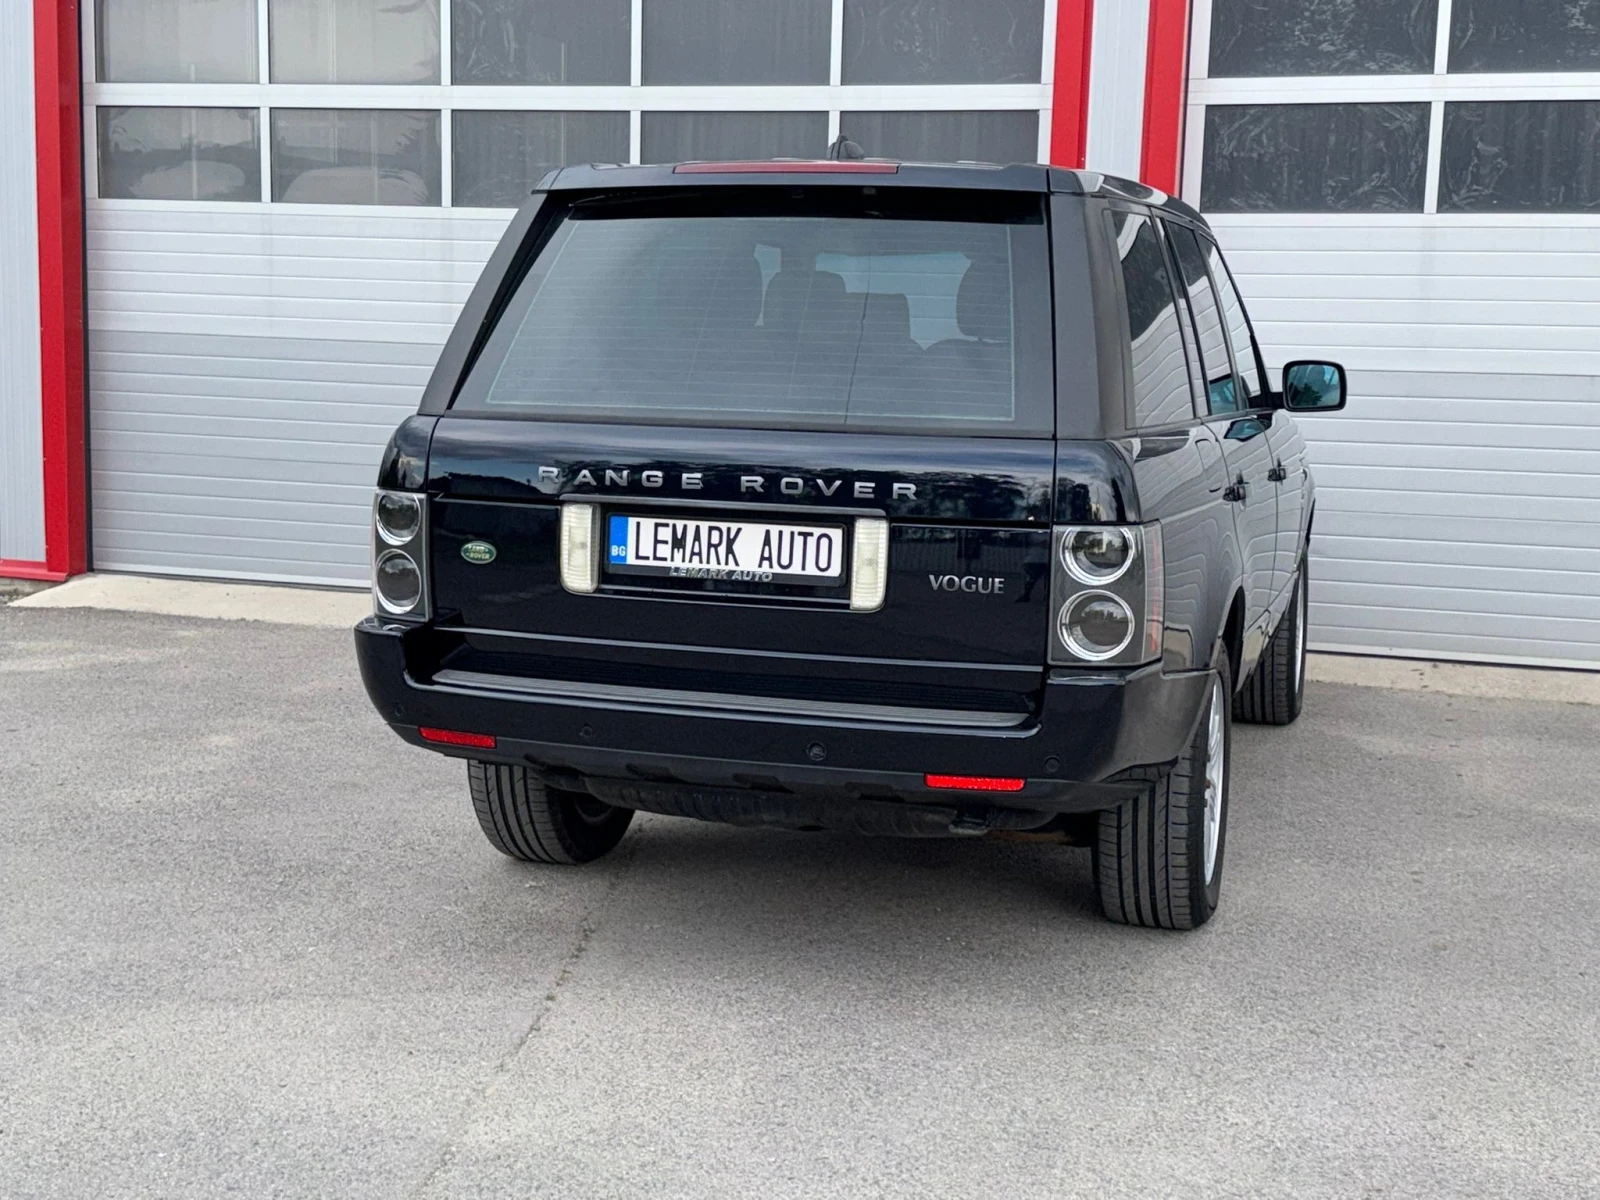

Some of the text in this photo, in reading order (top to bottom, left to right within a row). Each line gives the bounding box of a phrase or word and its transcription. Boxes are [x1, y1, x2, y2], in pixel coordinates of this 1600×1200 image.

[538, 466, 917, 500] RANGE ROVER
[611, 545, 626, 557] BG
[635, 521, 833, 572] LEMARK AUTO
[669, 566, 773, 582] LEMARK AUTO
[928, 574, 1005, 594] VOGUE
